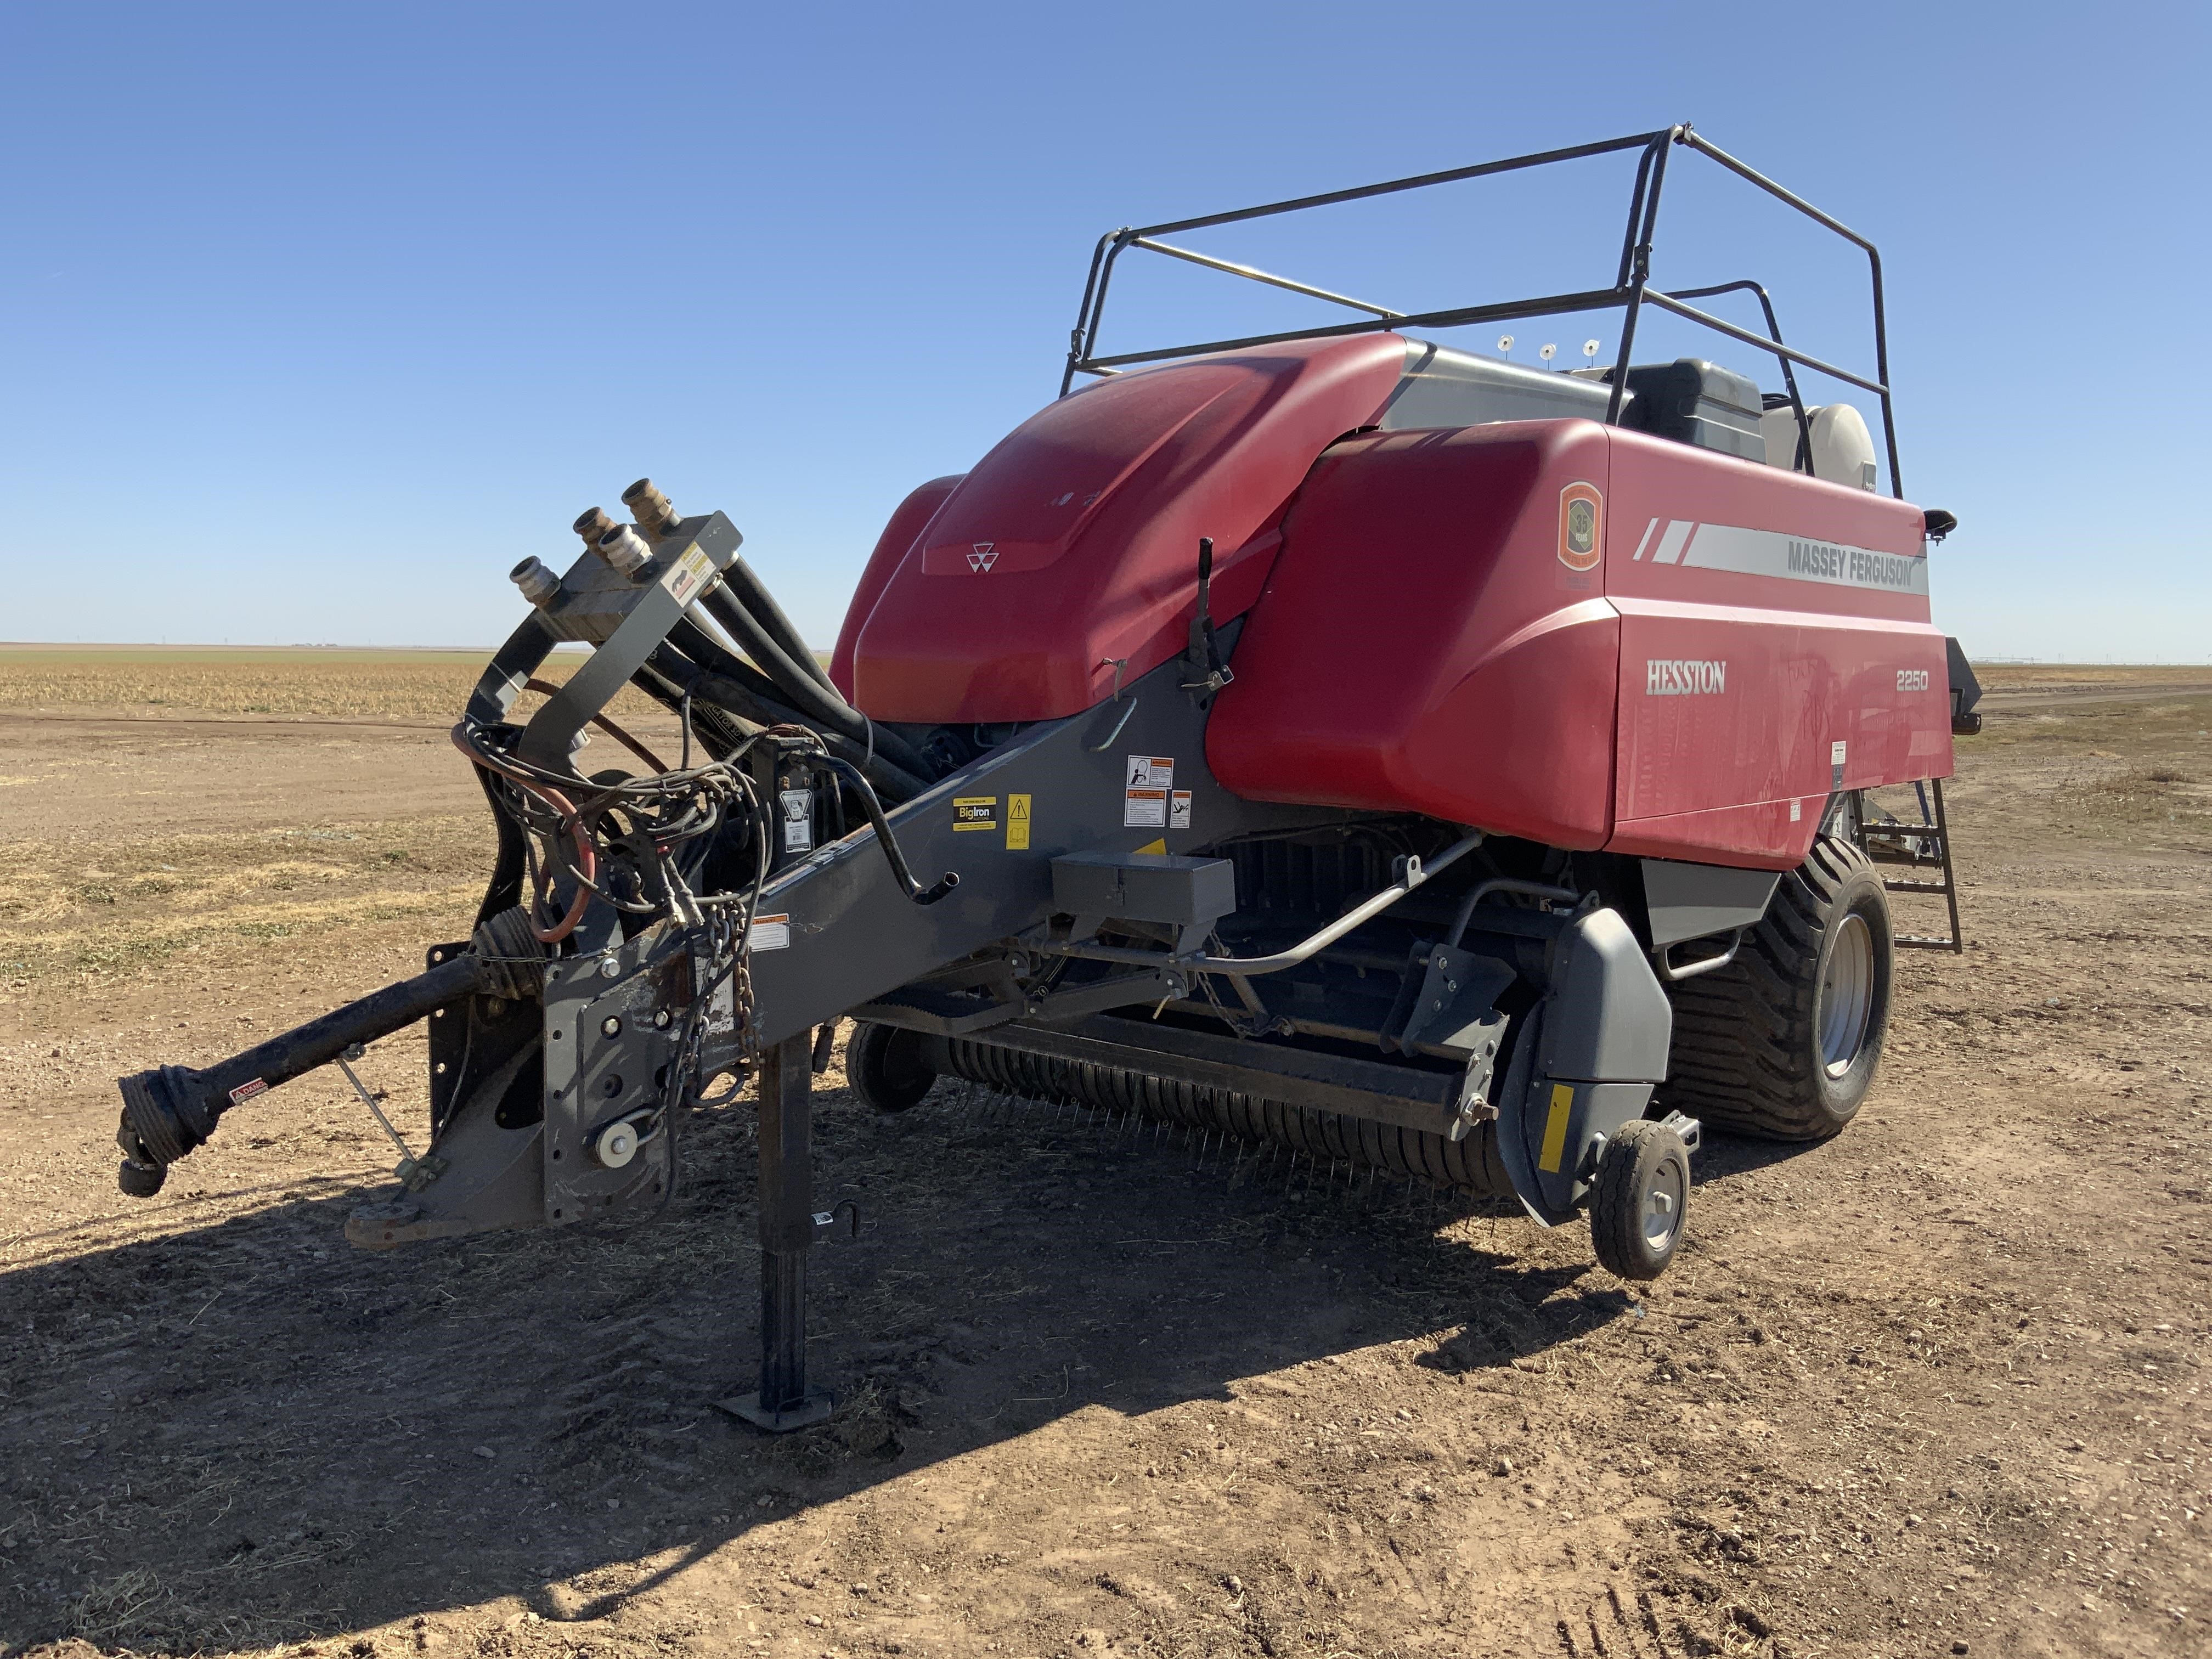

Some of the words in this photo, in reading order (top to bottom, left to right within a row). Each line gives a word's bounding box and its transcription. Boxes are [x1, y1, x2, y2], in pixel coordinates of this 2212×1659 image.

[1576, 514, 1588, 533] 35
[1576, 532, 1588, 542] YEARS
[1788, 541, 1846, 579] MASSEY
[1849, 551, 1912, 586] FERGUSON
[1646, 659, 1726, 696] HESSTON
[1896, 670, 1928, 691] 2250
[960, 806, 990, 820] BigIron
[243, 1081, 266, 1094] DANG
